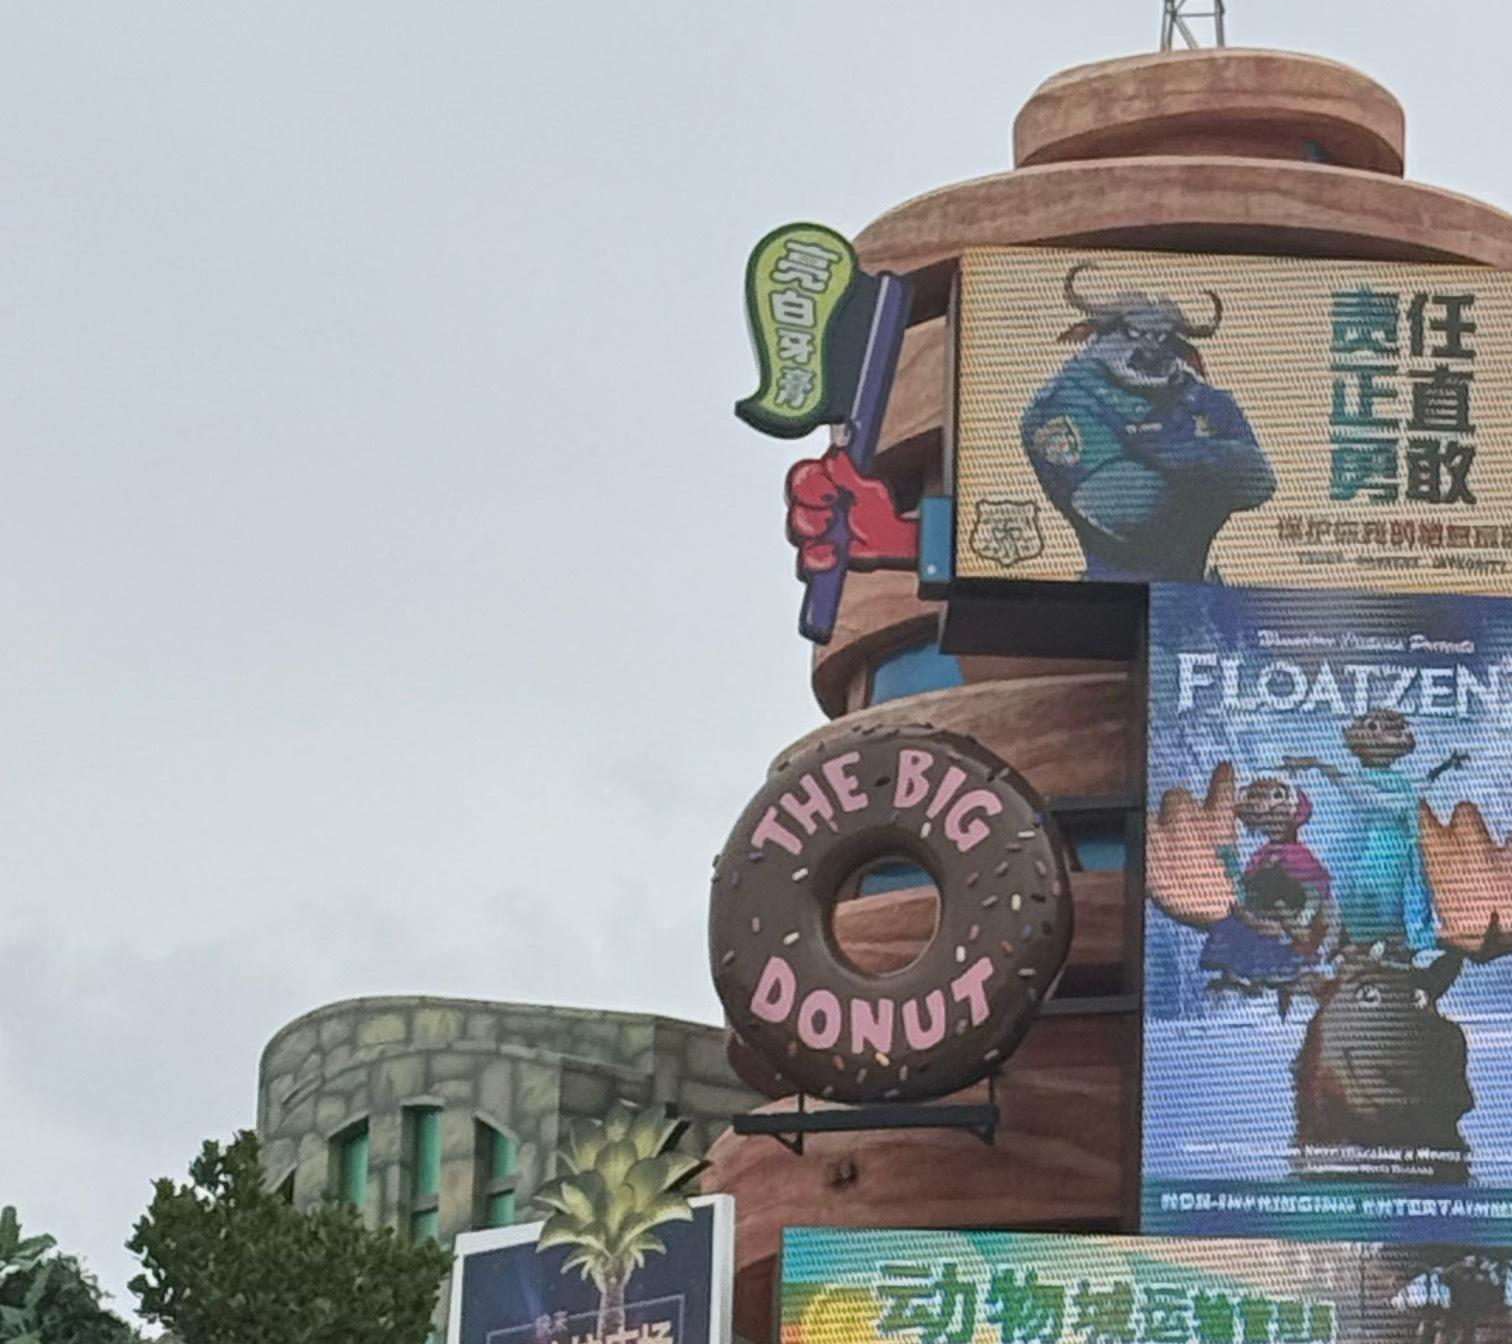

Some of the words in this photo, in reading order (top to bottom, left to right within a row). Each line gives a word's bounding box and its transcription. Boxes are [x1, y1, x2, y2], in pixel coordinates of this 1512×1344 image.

[1329, 284, 1477, 357] 责任
[1329, 363, 1477, 432] 正直
[1329, 435, 1477, 504] 勇敢
[751, 751, 870, 855] THE
[893, 749, 1003, 853] BIG
[750, 955, 994, 1055] DONUT
